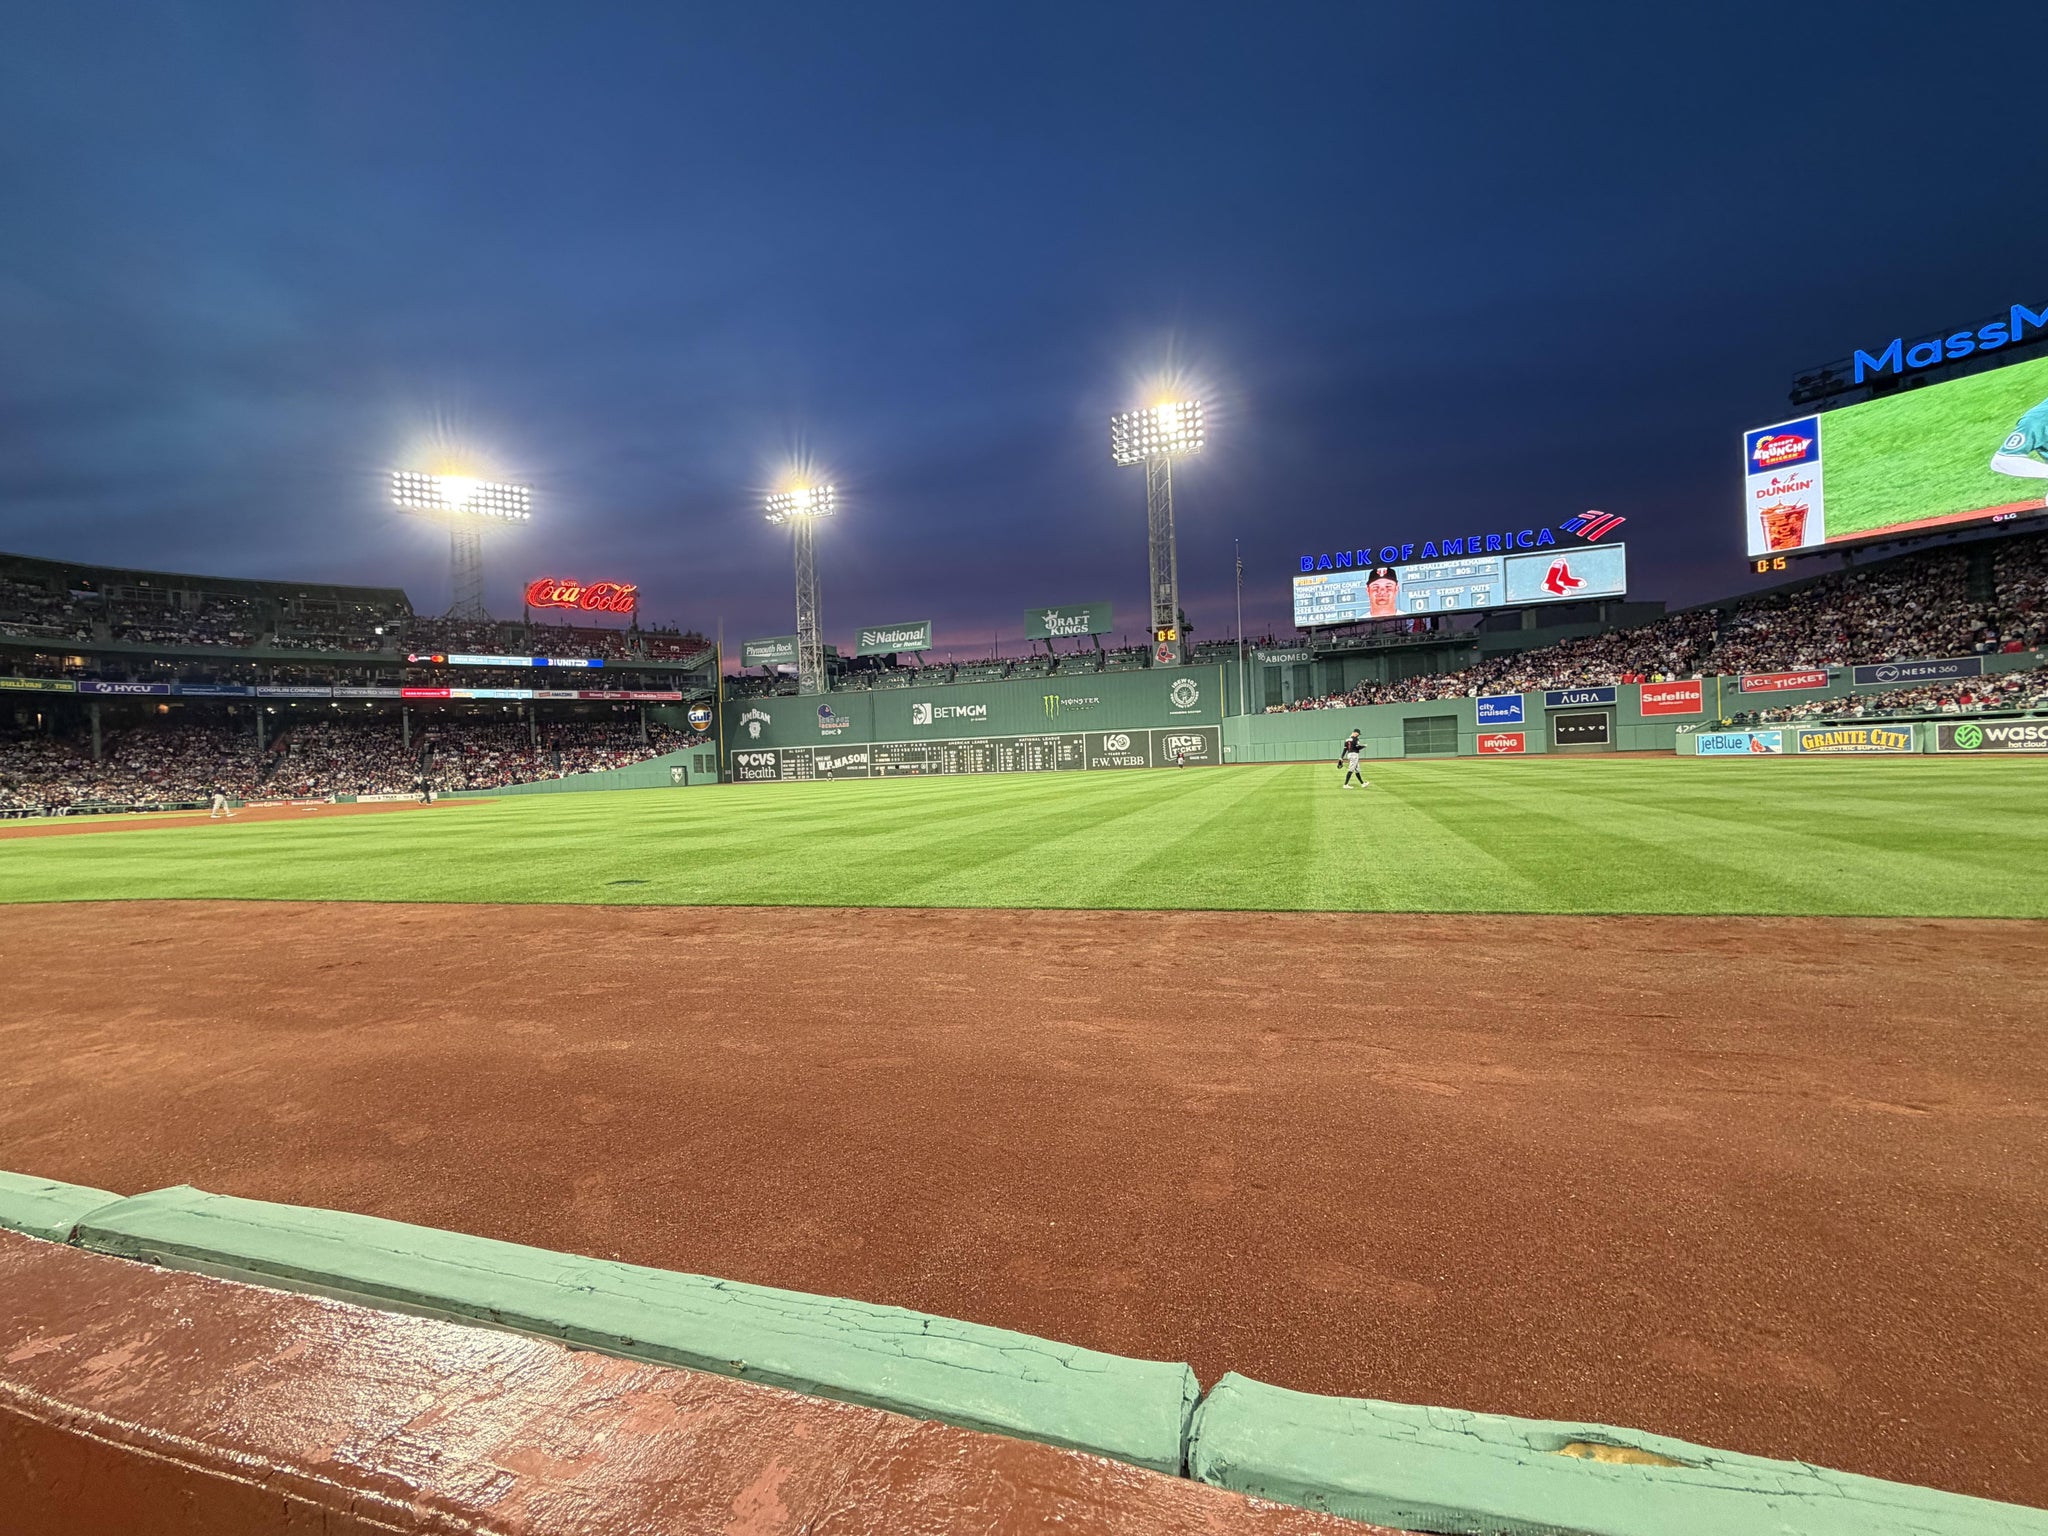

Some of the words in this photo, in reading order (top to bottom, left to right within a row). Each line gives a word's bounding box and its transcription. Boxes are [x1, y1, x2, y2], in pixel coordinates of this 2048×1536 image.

[1753, 439, 1813, 460] KRUNCHY
[1756, 479, 1813, 499] DUNKIN'
[1300, 548, 1372, 572] BANK
[1379, 543, 1414, 563] OF
[1421, 528, 1555, 558] AMERICA
[1757, 557, 1786, 573] 0:15
[527, 579, 638, 612] Coca-Cola
[1408, 590, 1431, 598] BALLS
[1436, 587, 1464, 595] STRIKES
[1470, 584, 1490, 592] OUTS
[1415, 600, 1424, 611] 0
[1446, 597, 1454, 607] 0
[1476, 594, 1485, 606] 2
[1045, 615, 1090, 630] DRAFT
[876, 627, 924, 644] National
[1050, 624, 1089, 636] KINGS
[1158, 630, 1176, 642] 0:15
[746, 645, 776, 655] Plymouth
[776, 643, 793, 652] Rock
[1265, 652, 1308, 663] ABIOMED
[1902, 664, 1937, 675] NESN
[1938, 665, 1958, 674] 360
[1171, 678, 1187, 688] IBEW
[1775, 674, 1825, 688] TICKET
[115, 684, 151, 692] HYCU
[1060, 697, 1100, 706] MONSTER
[1642, 691, 1700, 702] Safelite
[934, 704, 987, 718] BETMGM
[1479, 703, 1494, 711] city
[689, 712, 711, 722] Gulf
[740, 712, 752, 726] JIM
[752, 708, 771, 725] BEAM
[1103, 734, 1130, 752] 160
[1171, 736, 1202, 748] ACE
[1484, 739, 1518, 748] IRVING
[1701, 736, 1743, 752] jetBlue
[1802, 730, 1867, 749] GRANITE
[1870, 728, 1909, 749] CITY
[2008, 740, 2022, 748] hot
[2024, 740, 2047, 748] cloud
[750, 753, 775, 766] CVS
[1092, 758, 1110, 767] F.W.
[1112, 756, 1145, 766] WEBB
[740, 767, 776, 779] Health
